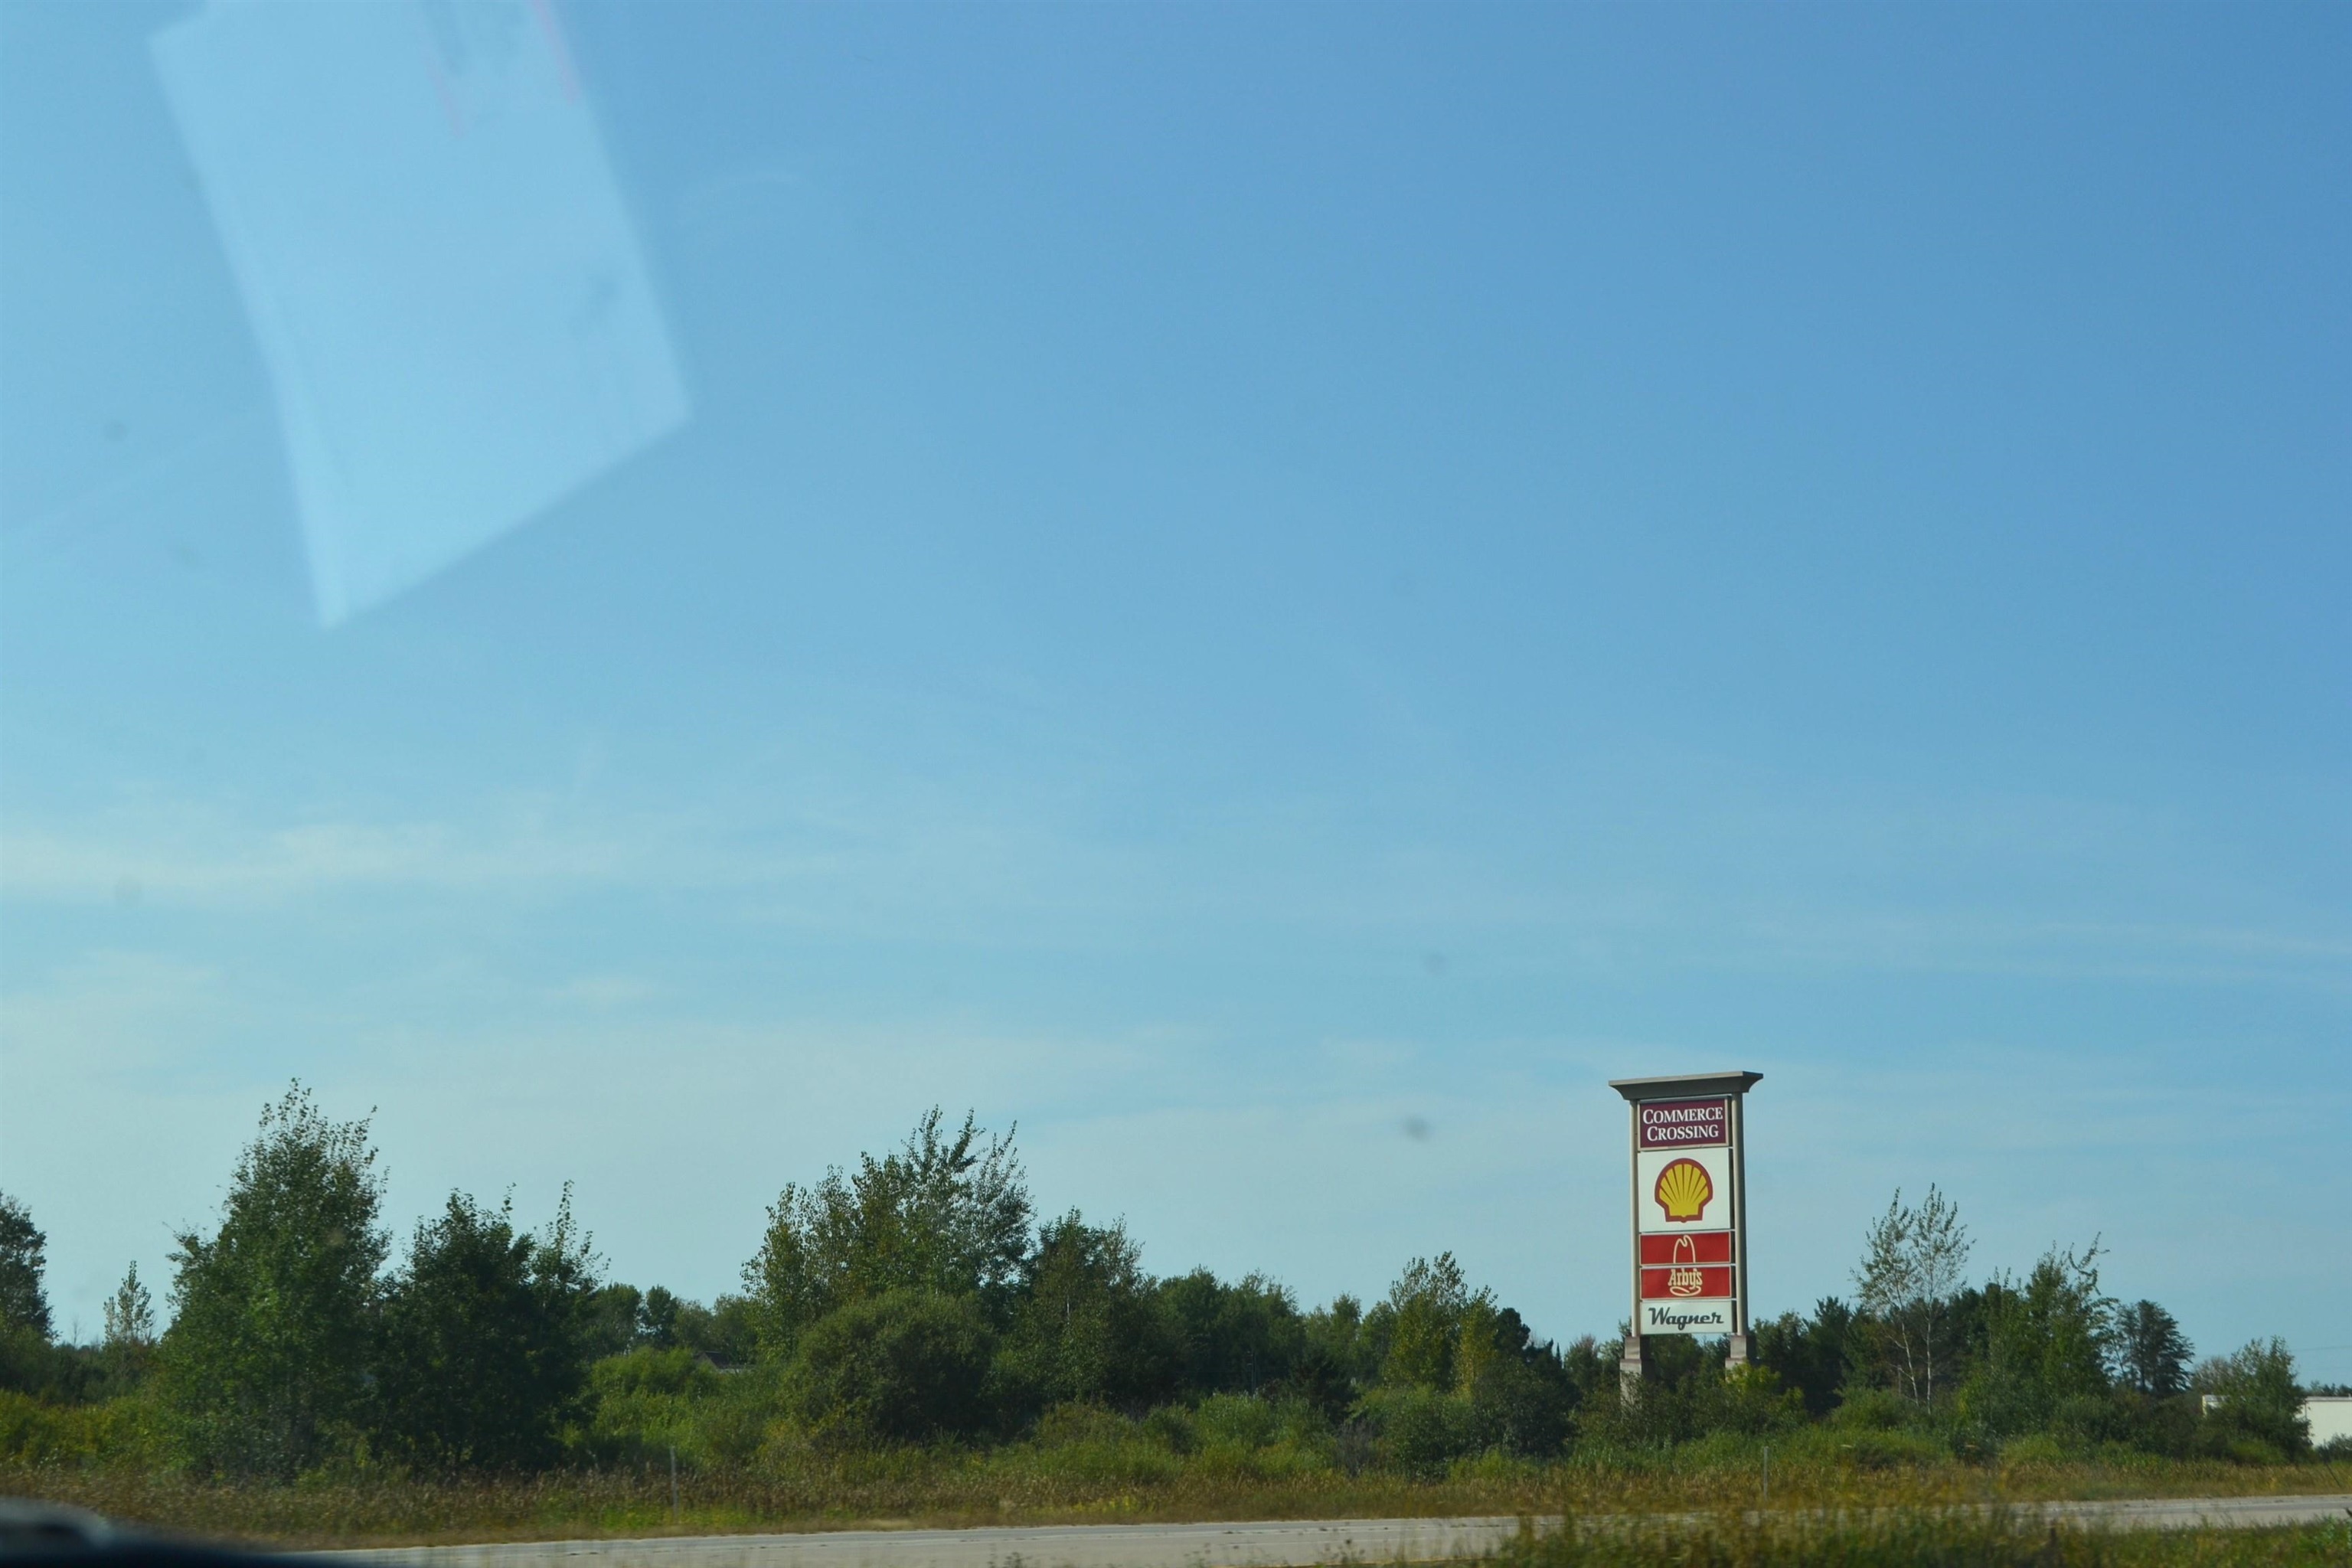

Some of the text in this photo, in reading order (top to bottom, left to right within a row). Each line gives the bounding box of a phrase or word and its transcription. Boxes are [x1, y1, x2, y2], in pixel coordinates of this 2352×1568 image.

[1642, 1106, 1723, 1124] COMMERCE
[1647, 1124, 1719, 1141] CROSSING
[1668, 1268, 1703, 1289] Arby's
[1648, 1307, 1724, 1331] Wagner
